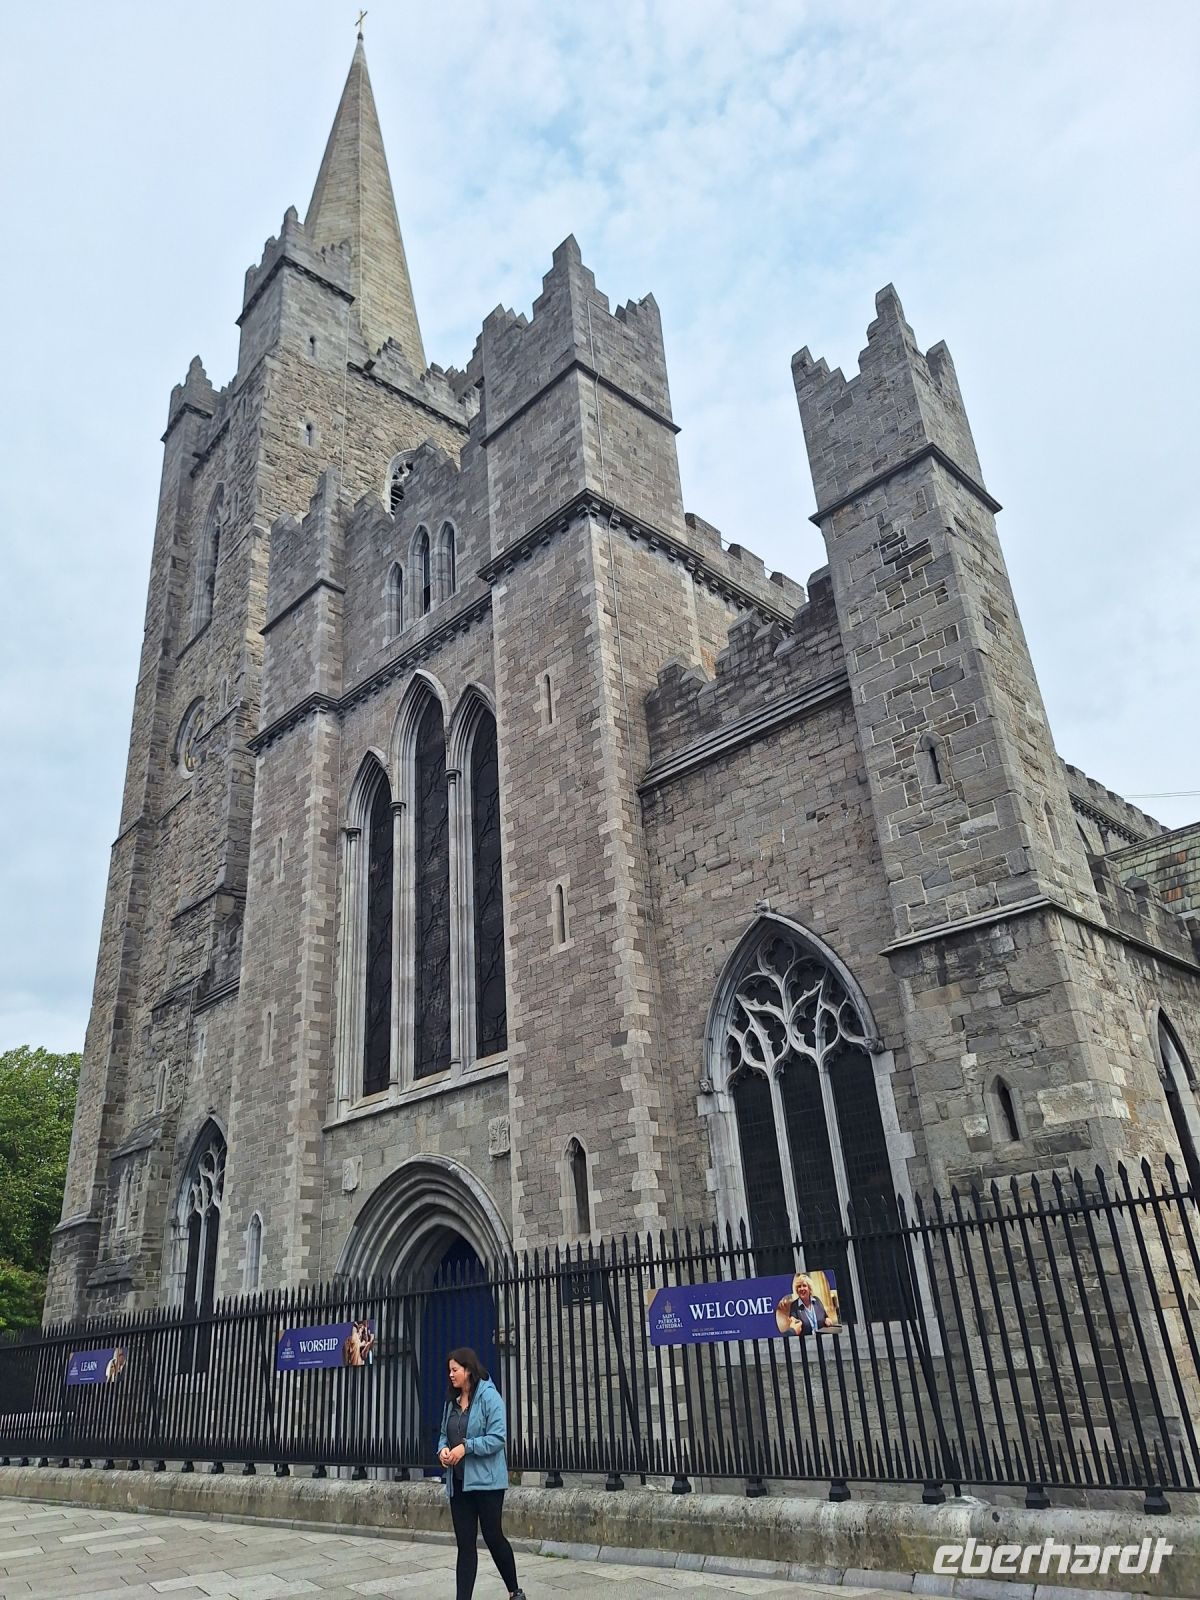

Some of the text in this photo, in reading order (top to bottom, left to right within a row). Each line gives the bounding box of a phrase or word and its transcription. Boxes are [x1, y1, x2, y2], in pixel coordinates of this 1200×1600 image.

[689, 1297, 773, 1320] WELCOME
[299, 1338, 338, 1353] WORSHIP
[81, 1361, 97, 1371] LEARN
